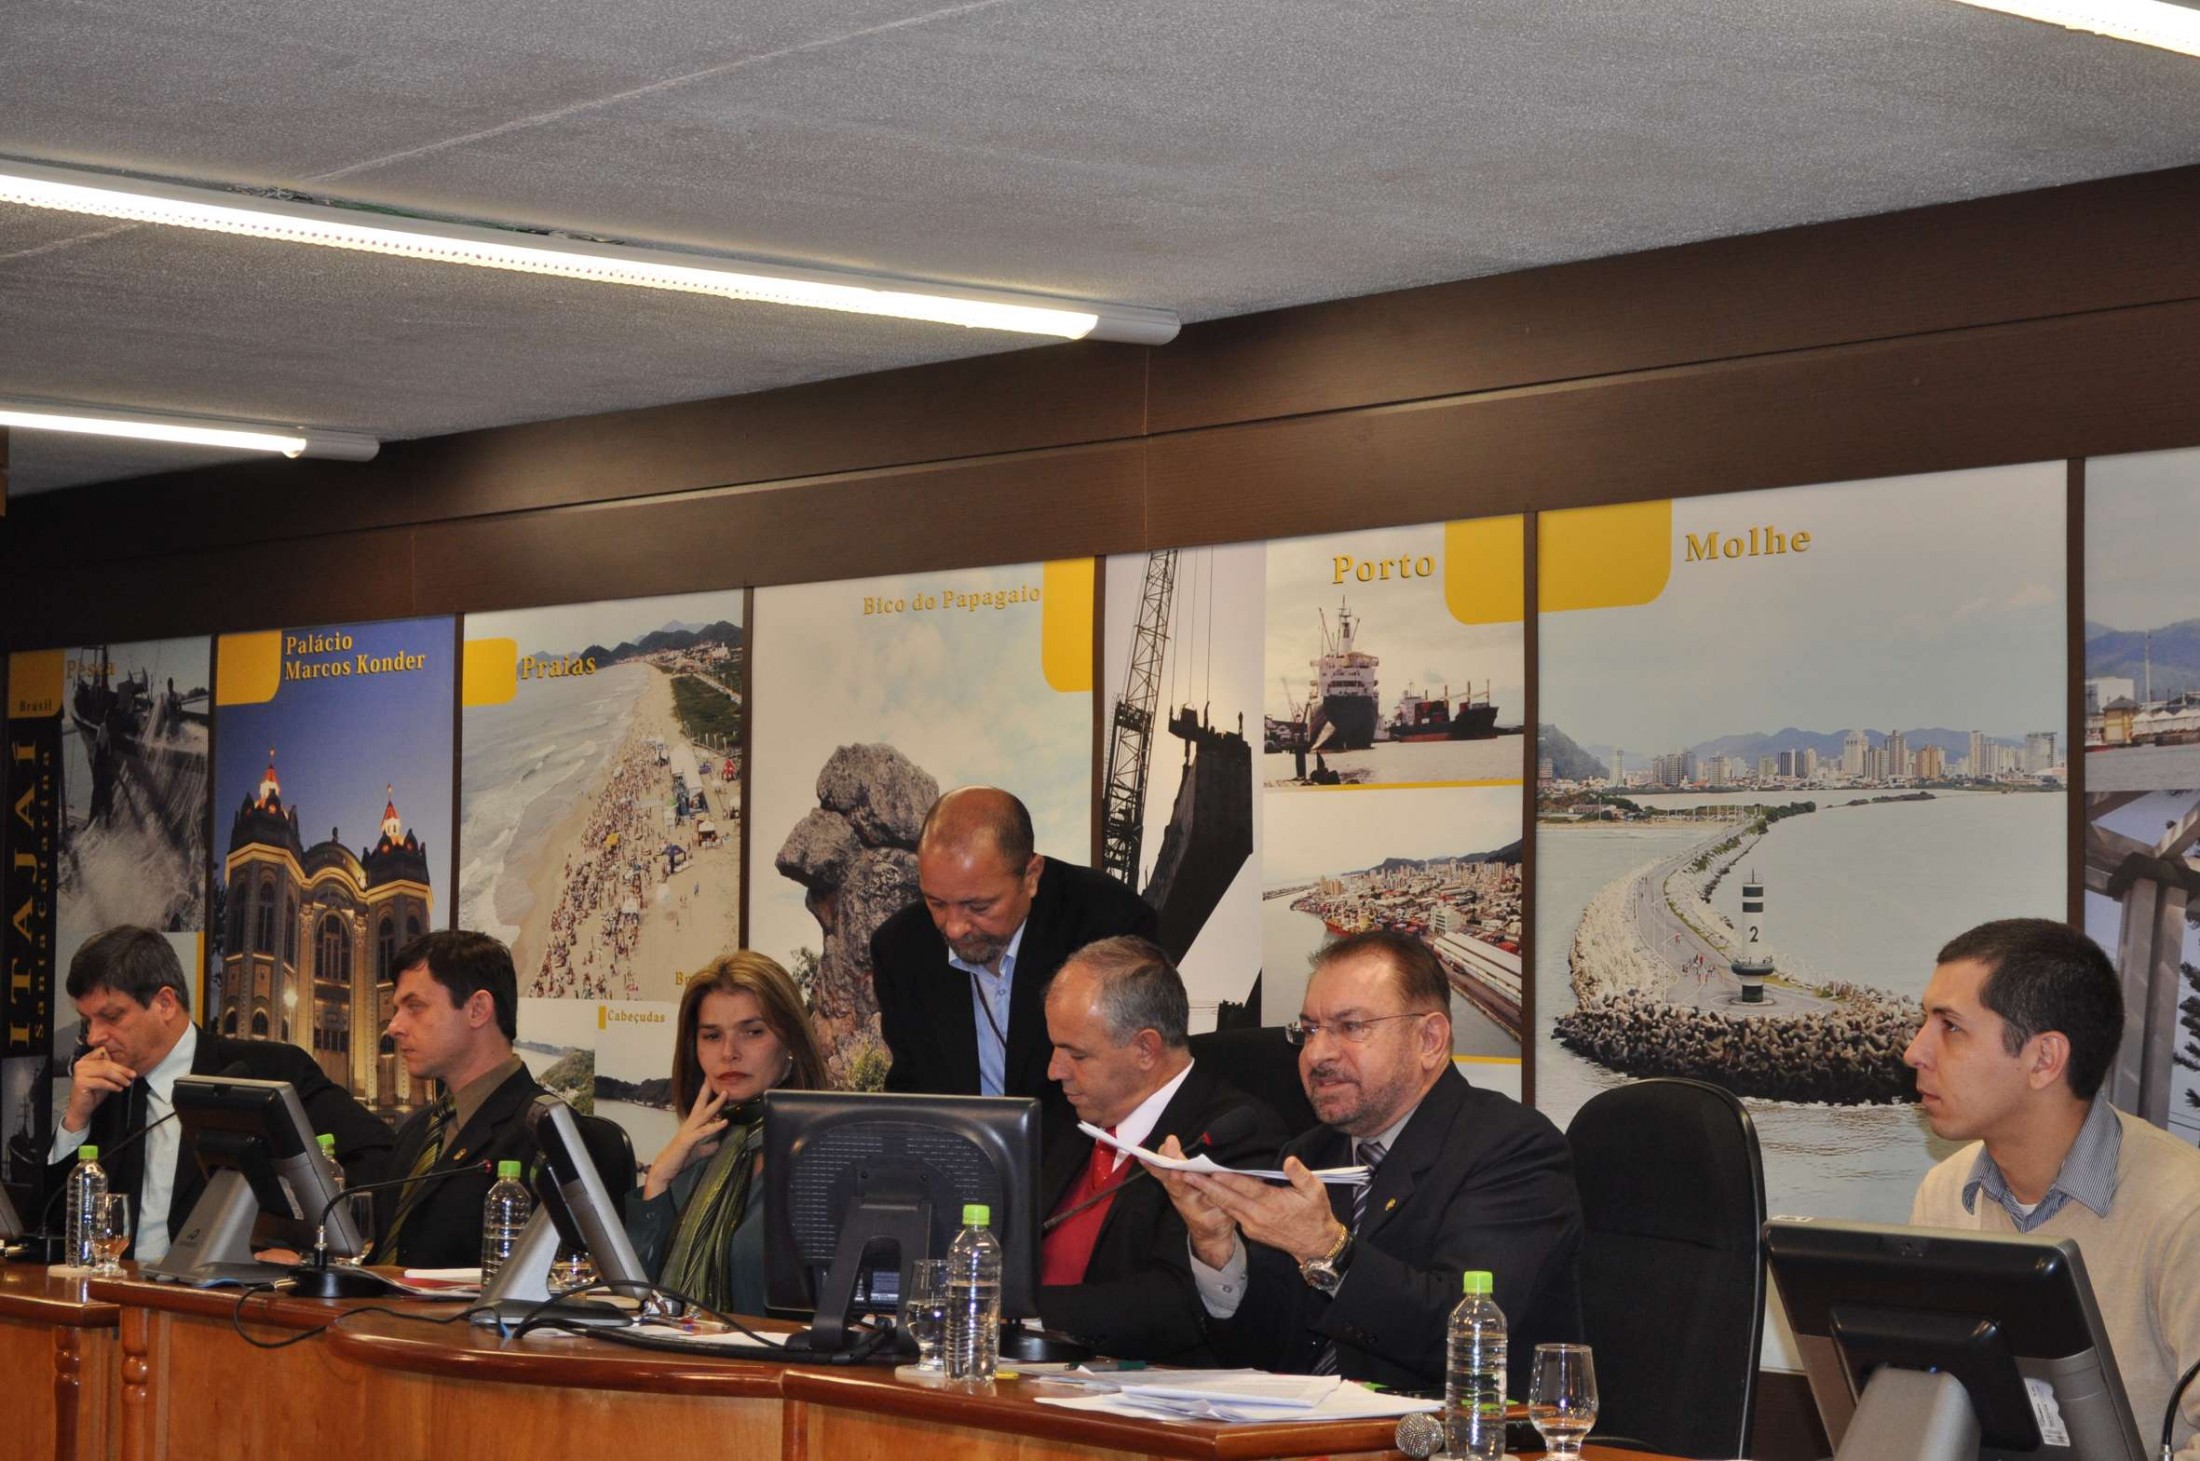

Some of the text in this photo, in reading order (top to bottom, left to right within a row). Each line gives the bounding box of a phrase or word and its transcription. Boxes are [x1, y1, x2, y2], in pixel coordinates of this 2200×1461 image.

[1685, 525, 1811, 561] Molhe
[1332, 554, 1435, 584] Porto
[863, 584, 1040, 615] Bico do Papagaio
[286, 631, 353, 655] Palácio
[285, 650, 426, 680] Marcos Konder
[521, 655, 596, 679] Praias
[20, 699, 52, 712] Brasil
[10, 740, 37, 1047] ITAJAÍ
[34, 751, 50, 1040] Santa Catarina
[1749, 925, 1758, 943] 2
[608, 1009, 666, 1024] Cabeçudas
